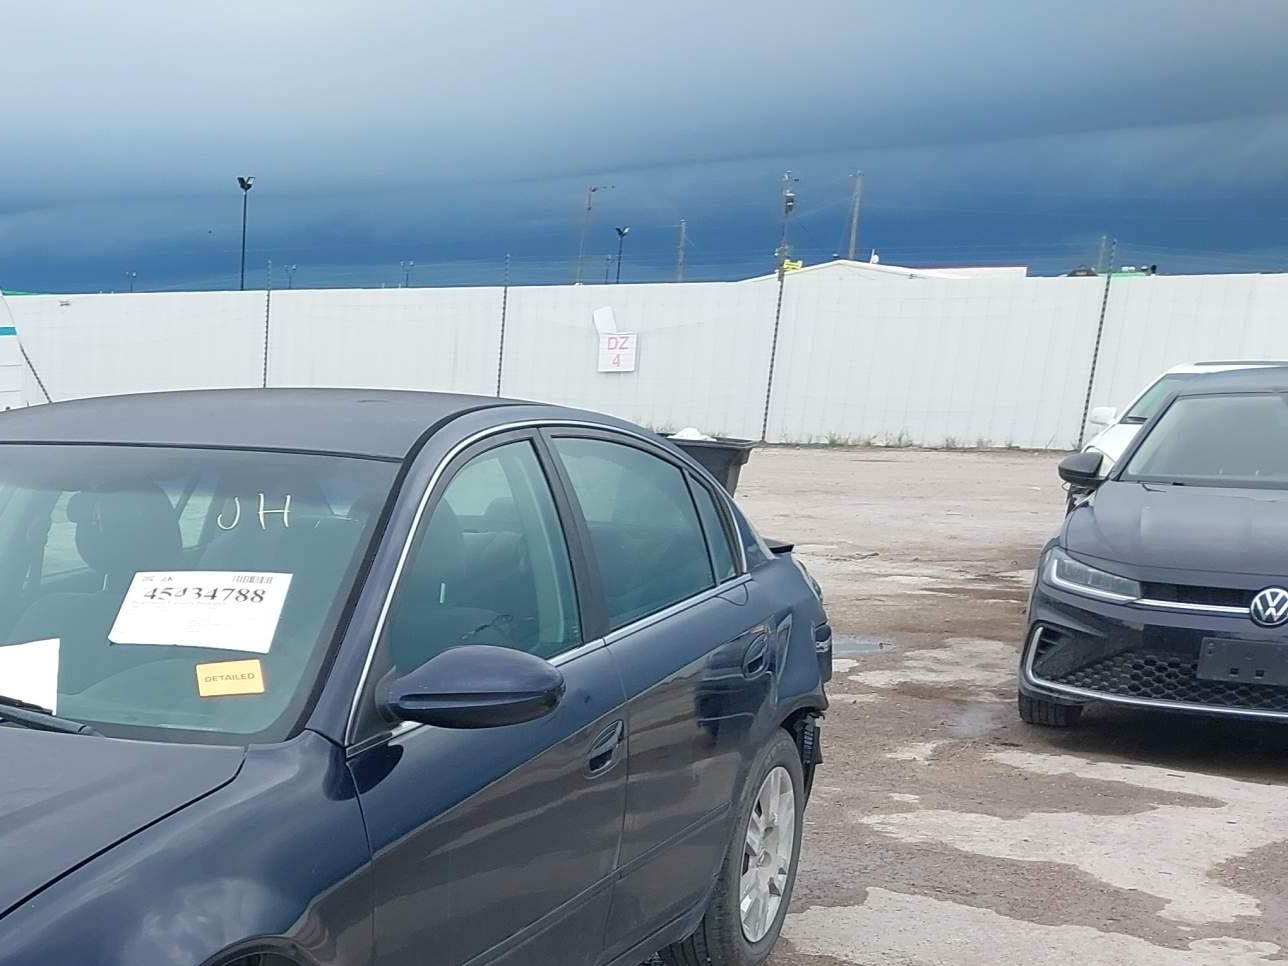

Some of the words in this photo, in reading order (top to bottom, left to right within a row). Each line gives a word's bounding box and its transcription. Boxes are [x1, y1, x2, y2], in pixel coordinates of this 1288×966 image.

[607, 336, 629, 350] DZ
[611, 353, 621, 367] 4
[144, 587, 266, 602] 45434788
[204, 672, 255, 683] DETAILED
